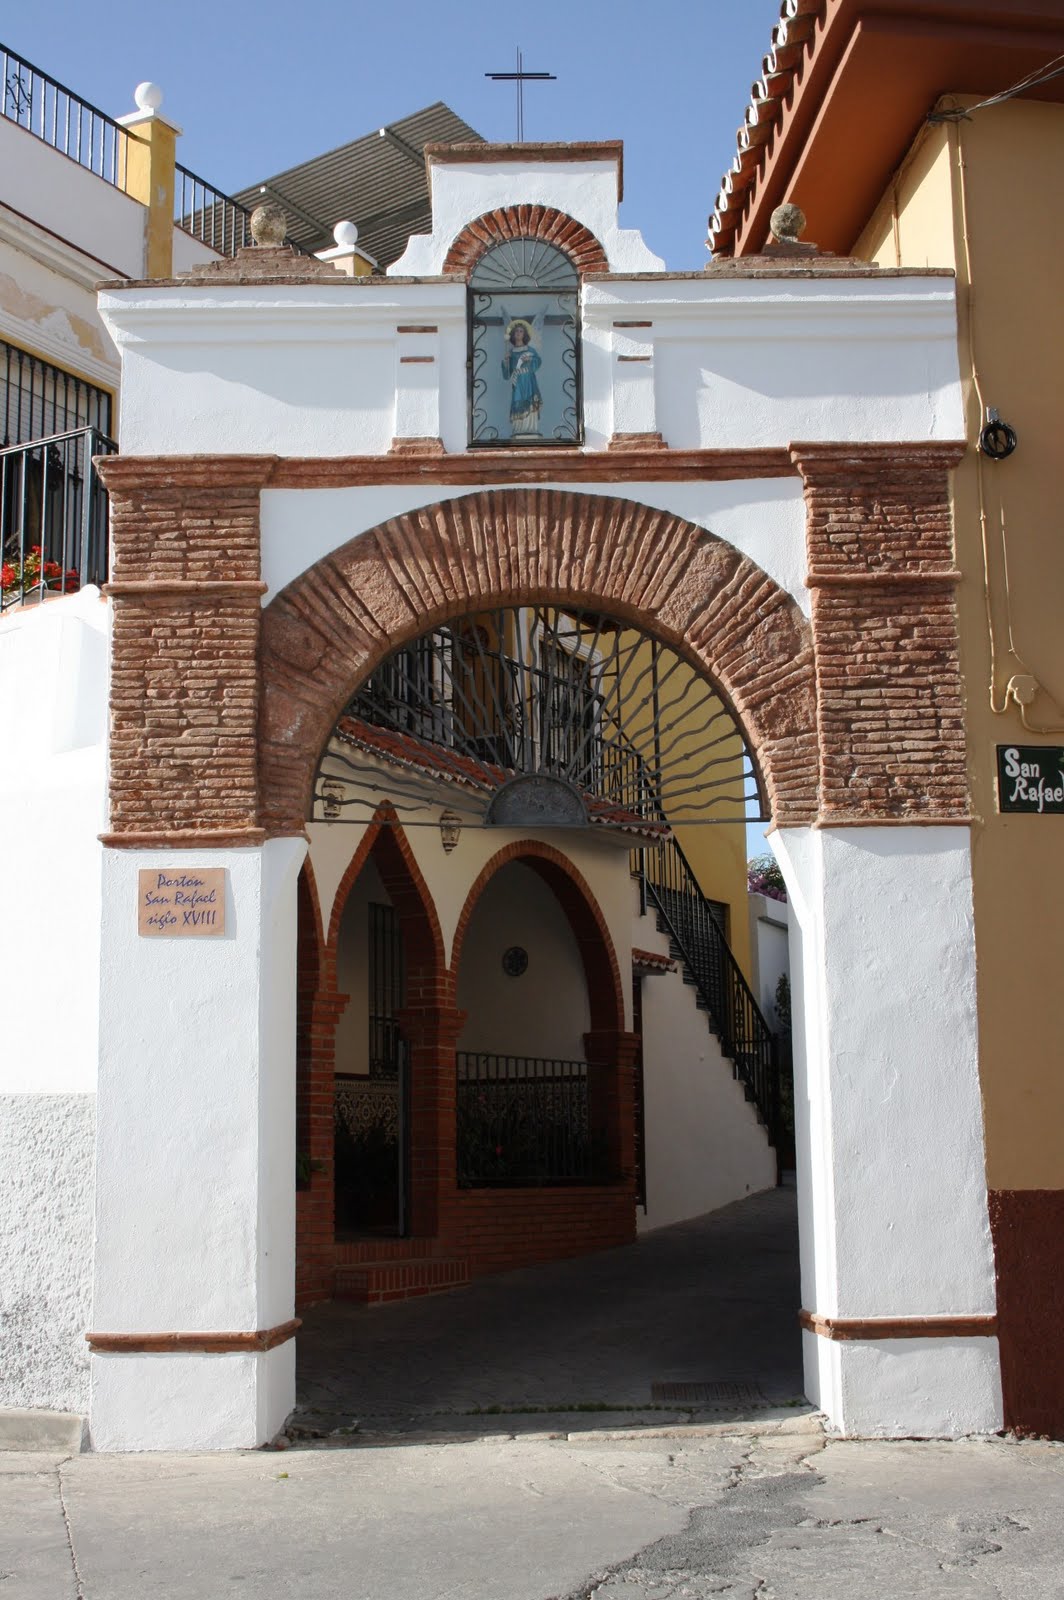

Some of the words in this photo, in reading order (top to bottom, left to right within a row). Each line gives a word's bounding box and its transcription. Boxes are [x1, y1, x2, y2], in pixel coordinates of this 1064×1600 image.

[1004, 748, 1040, 778] San
[157, 873, 204, 889] Portón
[145, 890, 170, 906] San
[175, 888, 217, 908] Rafael
[146, 910, 177, 930] siglo
[182, 910, 216, 926] XVIII
